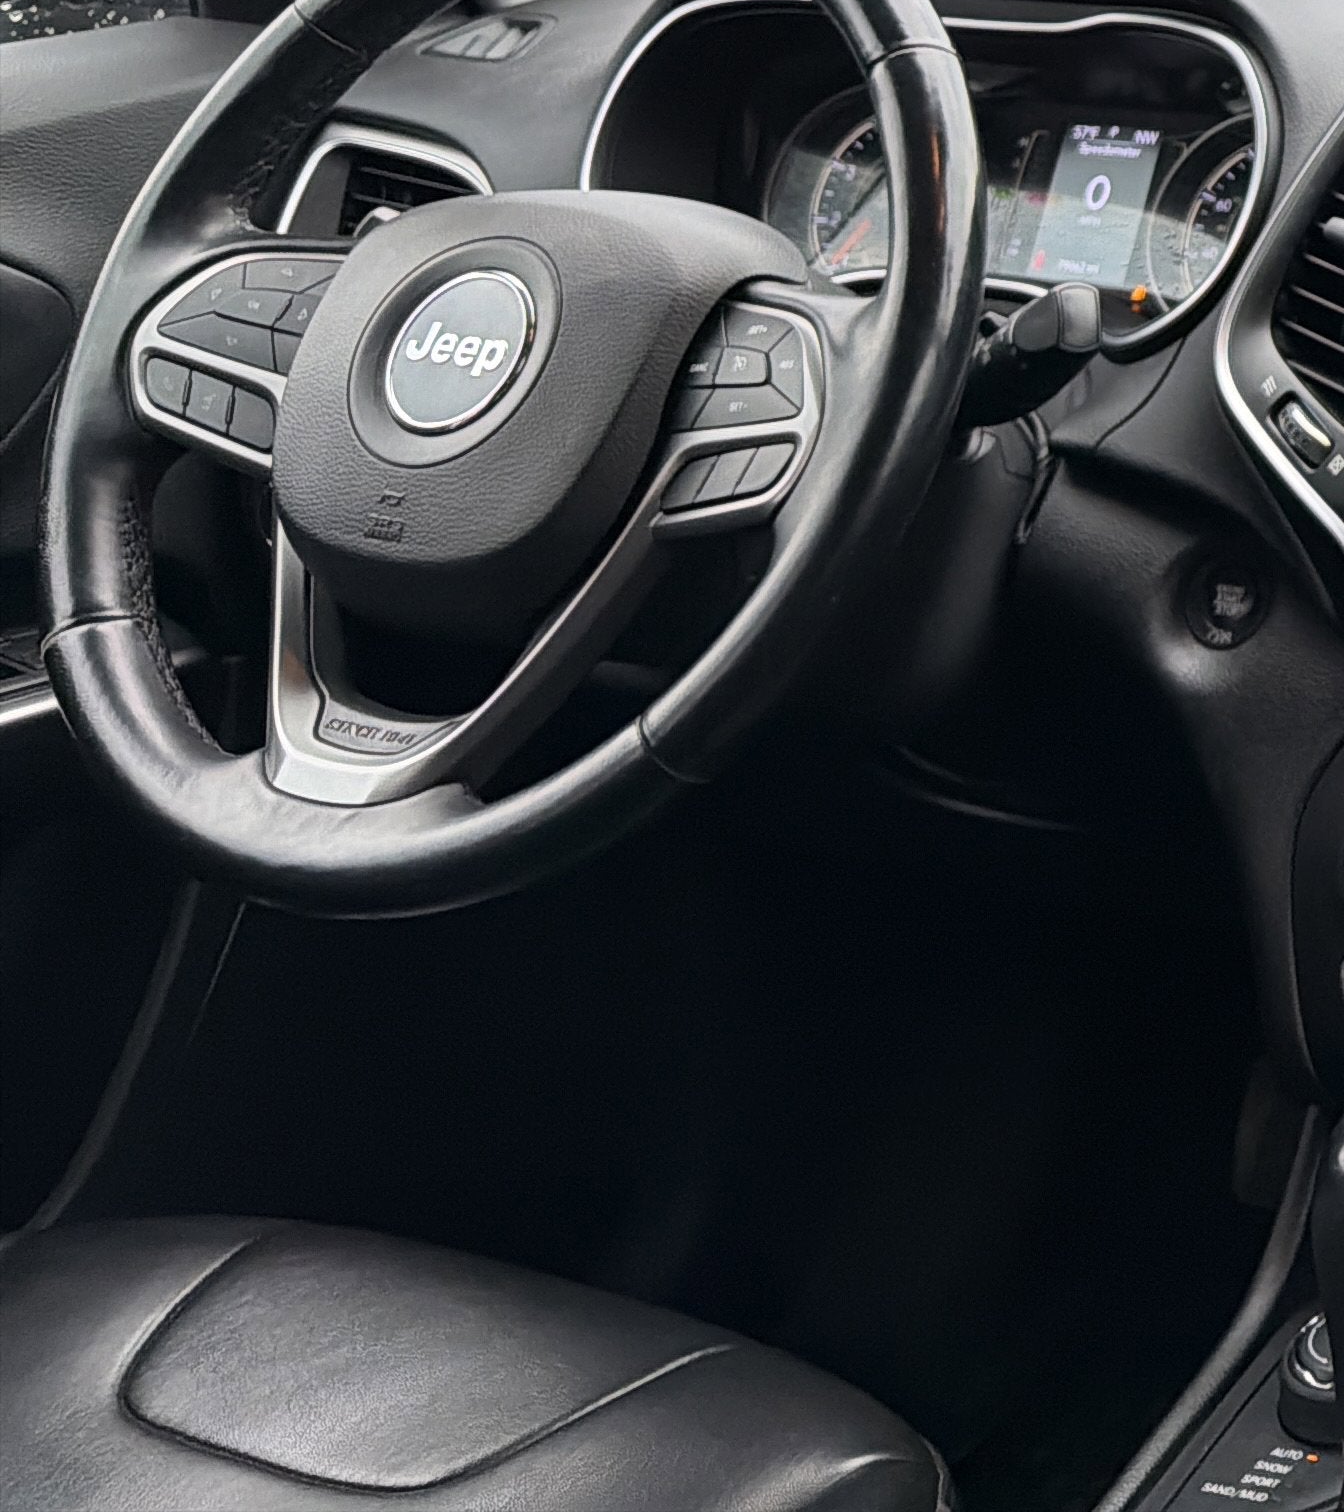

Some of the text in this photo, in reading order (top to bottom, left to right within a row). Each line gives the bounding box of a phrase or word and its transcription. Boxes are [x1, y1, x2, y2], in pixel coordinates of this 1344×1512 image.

[1085, 174, 1112, 211] 0
[406, 321, 508, 376] Jeep
[1269, 1446, 1304, 1461] AUTO
[1253, 1460, 1294, 1475] SNOW
[1240, 1474, 1281, 1488] SPORT
[1200, 1482, 1269, 1502] SAND/MUD
